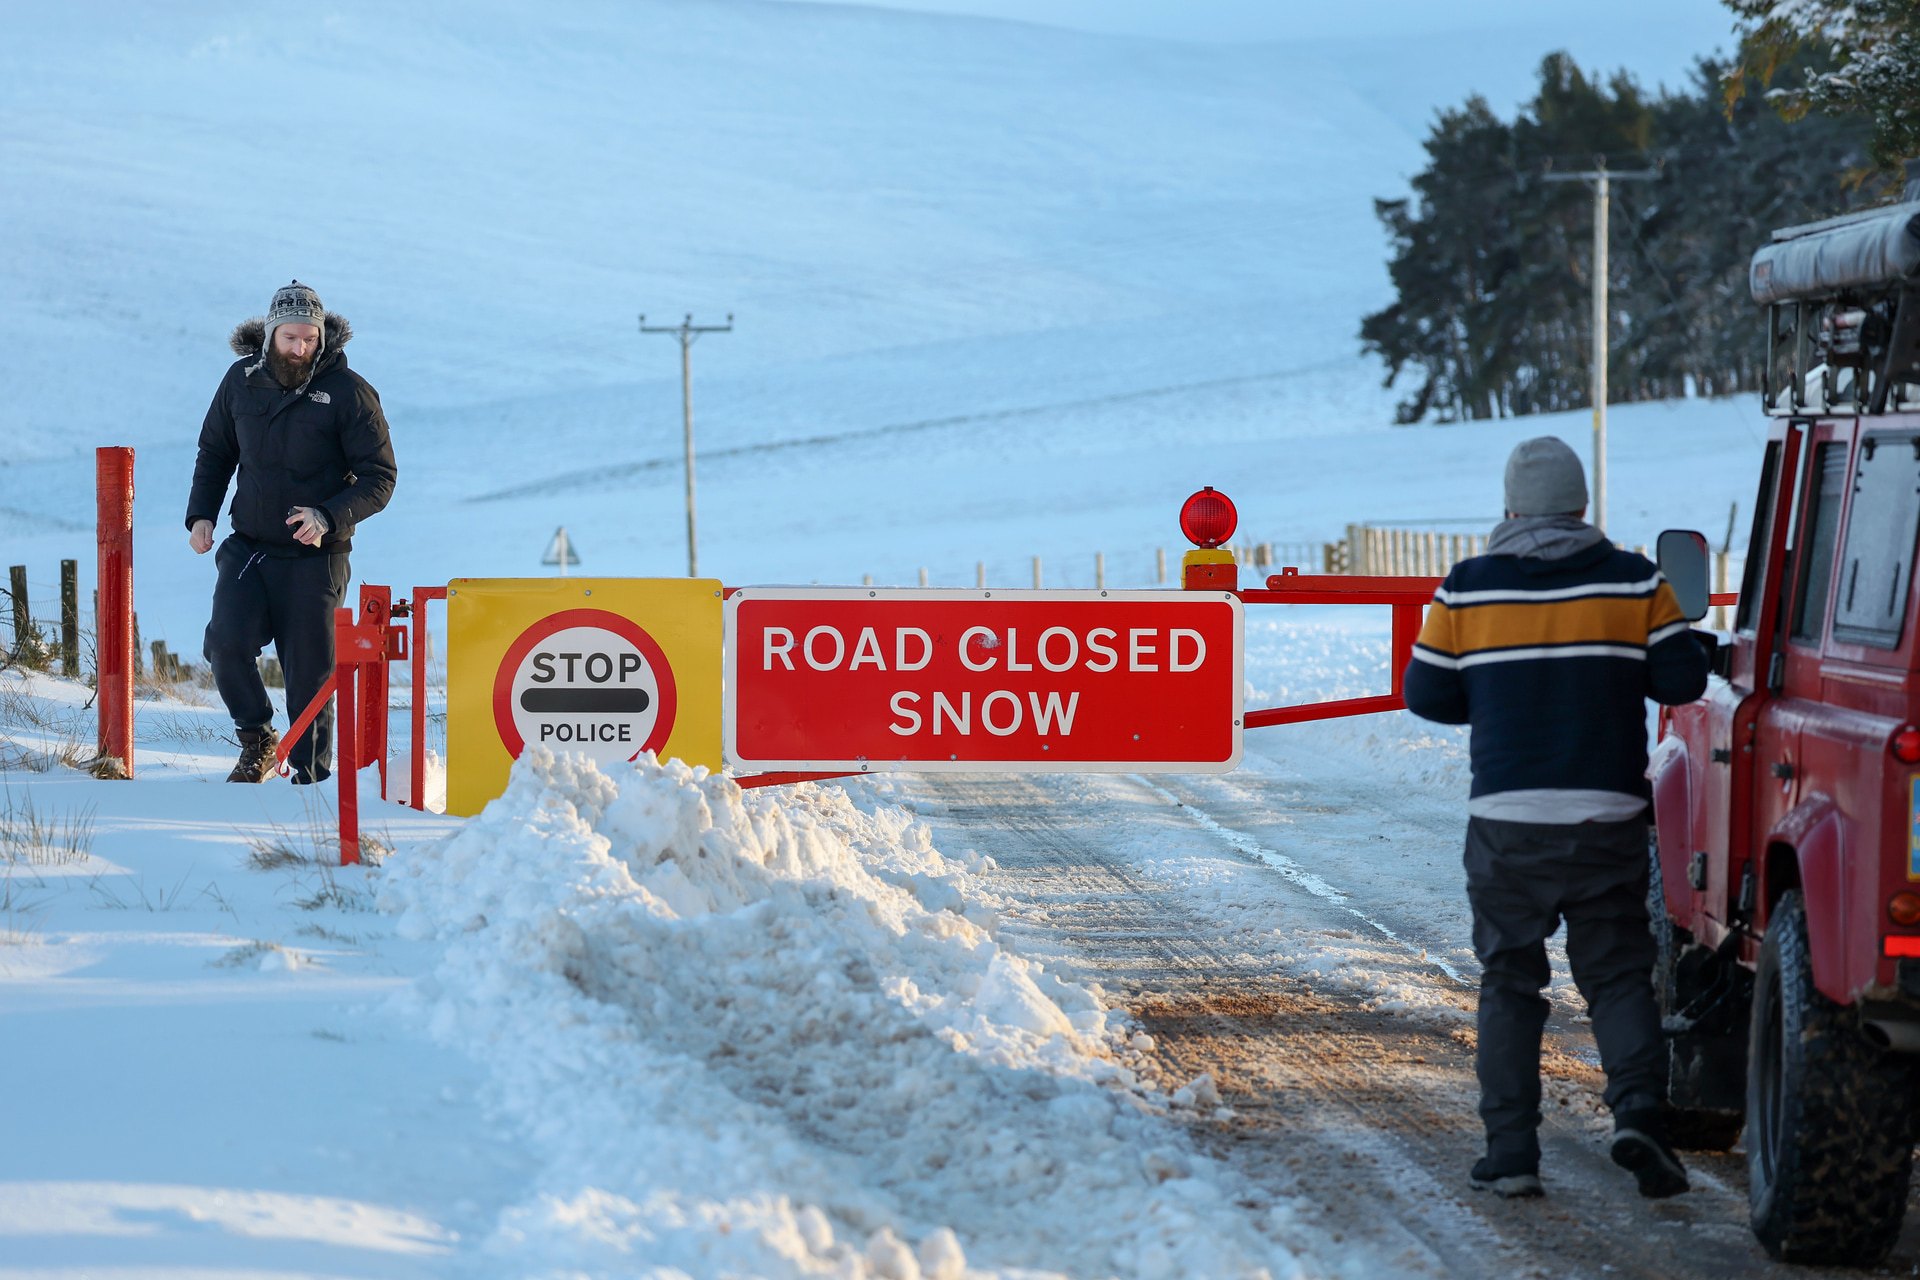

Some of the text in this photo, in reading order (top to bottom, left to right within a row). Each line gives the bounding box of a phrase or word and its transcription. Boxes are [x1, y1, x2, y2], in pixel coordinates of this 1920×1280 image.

[530, 652, 642, 684] STOP
[763, 625, 1207, 673] ROAD CLOSED
[540, 723, 632, 742] POLICE
[888, 690, 1080, 737] SNOW
